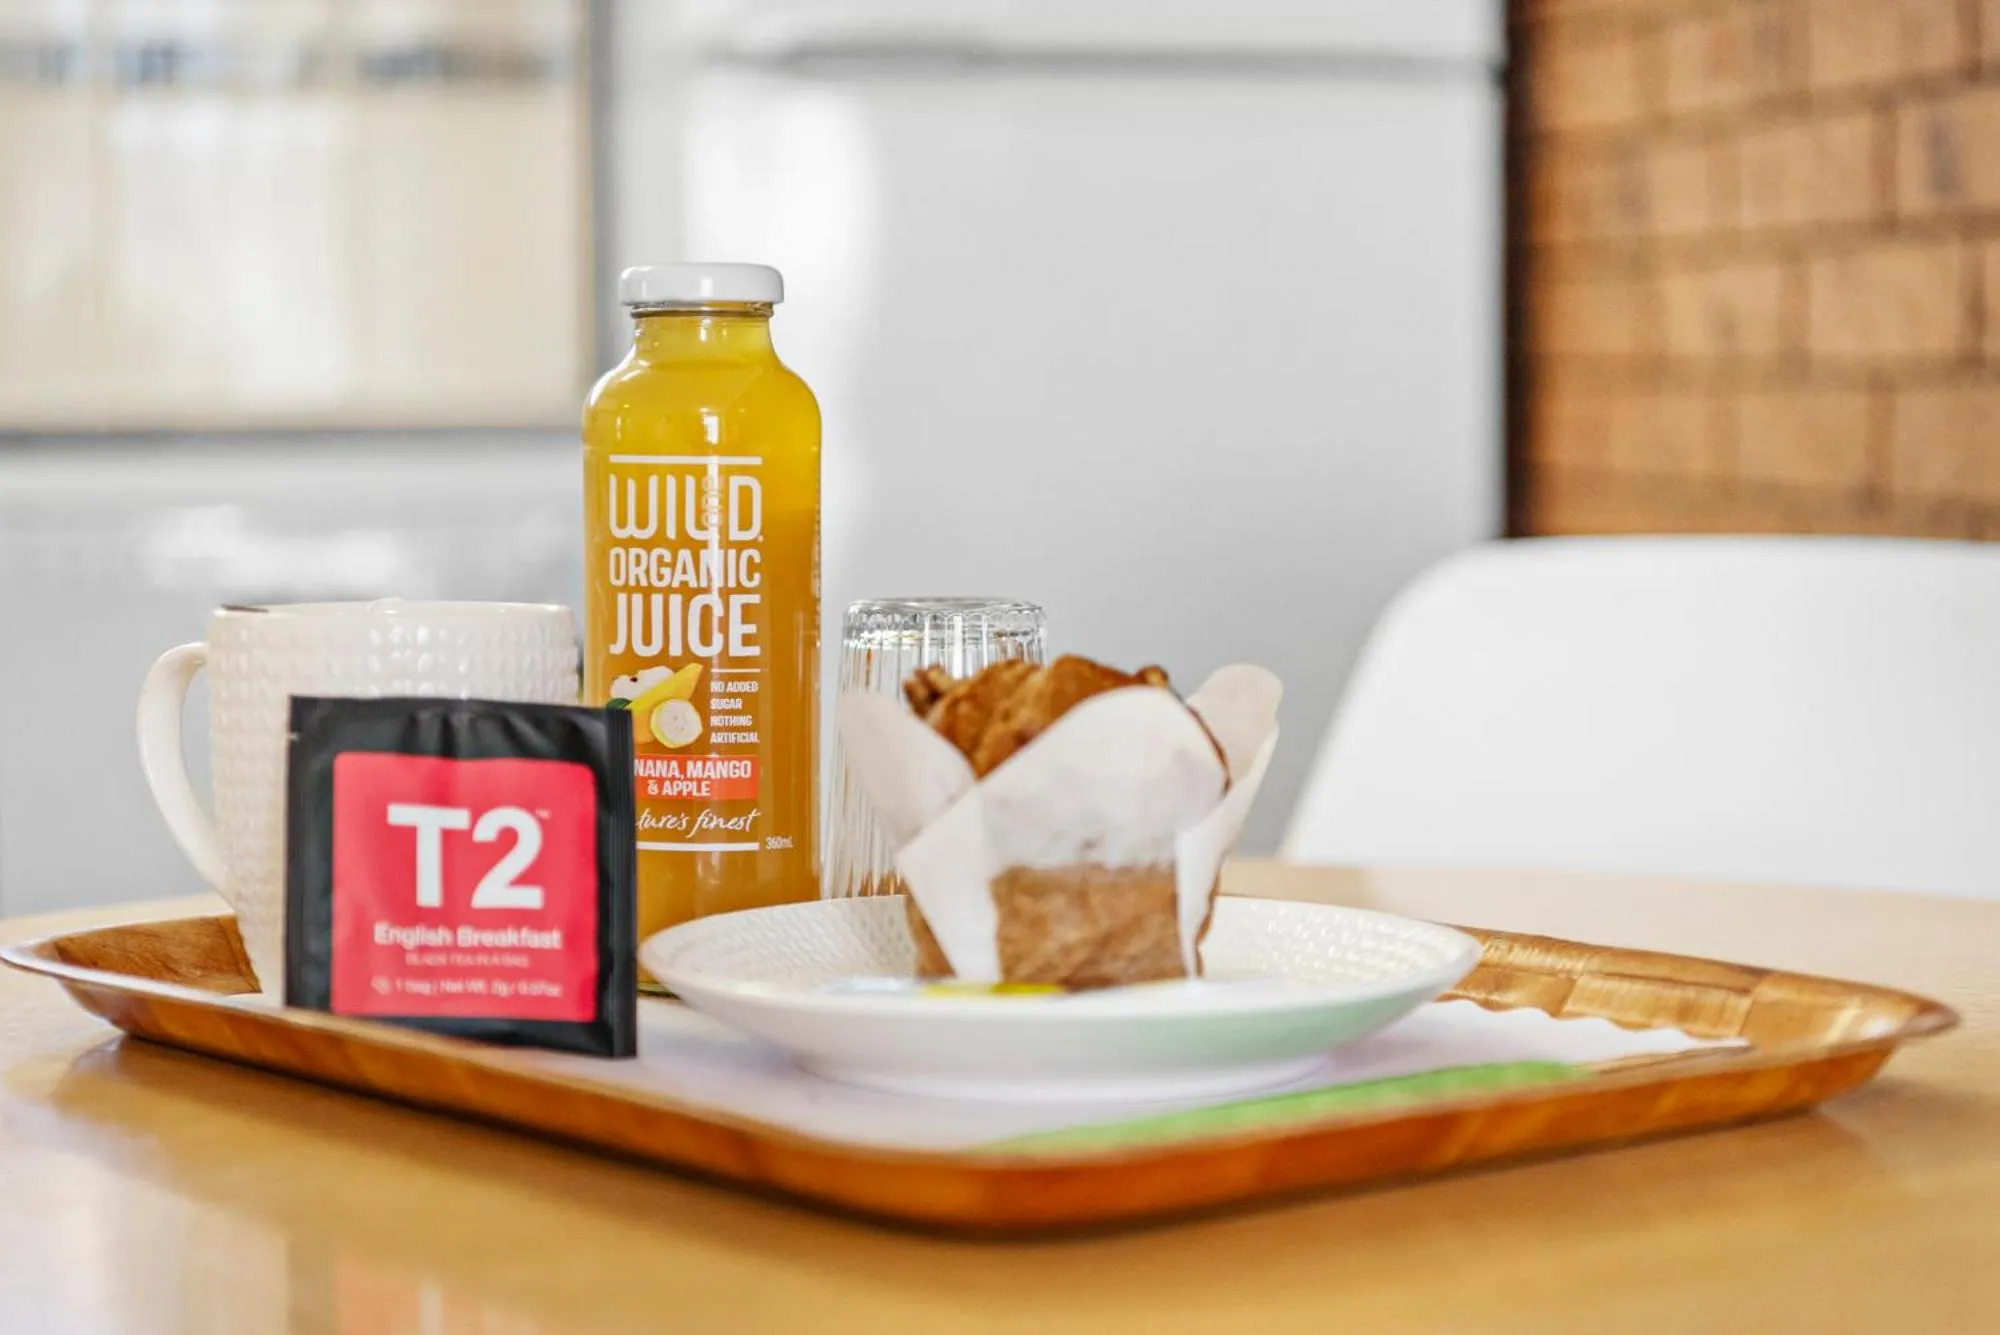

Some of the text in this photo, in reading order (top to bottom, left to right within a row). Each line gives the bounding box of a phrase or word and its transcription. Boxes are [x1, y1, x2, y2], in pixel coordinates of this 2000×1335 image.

[609, 474, 761, 541] WILD
[609, 547, 761, 588] ORGANIC
[609, 592, 761, 657] JUICE
[710, 681, 759, 693] NO ADDED
[710, 698, 743, 710] SUGAR
[710, 715, 753, 727] NOTHING
[710, 732, 760, 744] ARTIFICIAL
[634, 759, 752, 780] NANA, MANGO
[647, 780, 711, 797] & APPLE
[635, 807, 762, 838] ture's finest
[373, 921, 562, 950] English Breakfast
